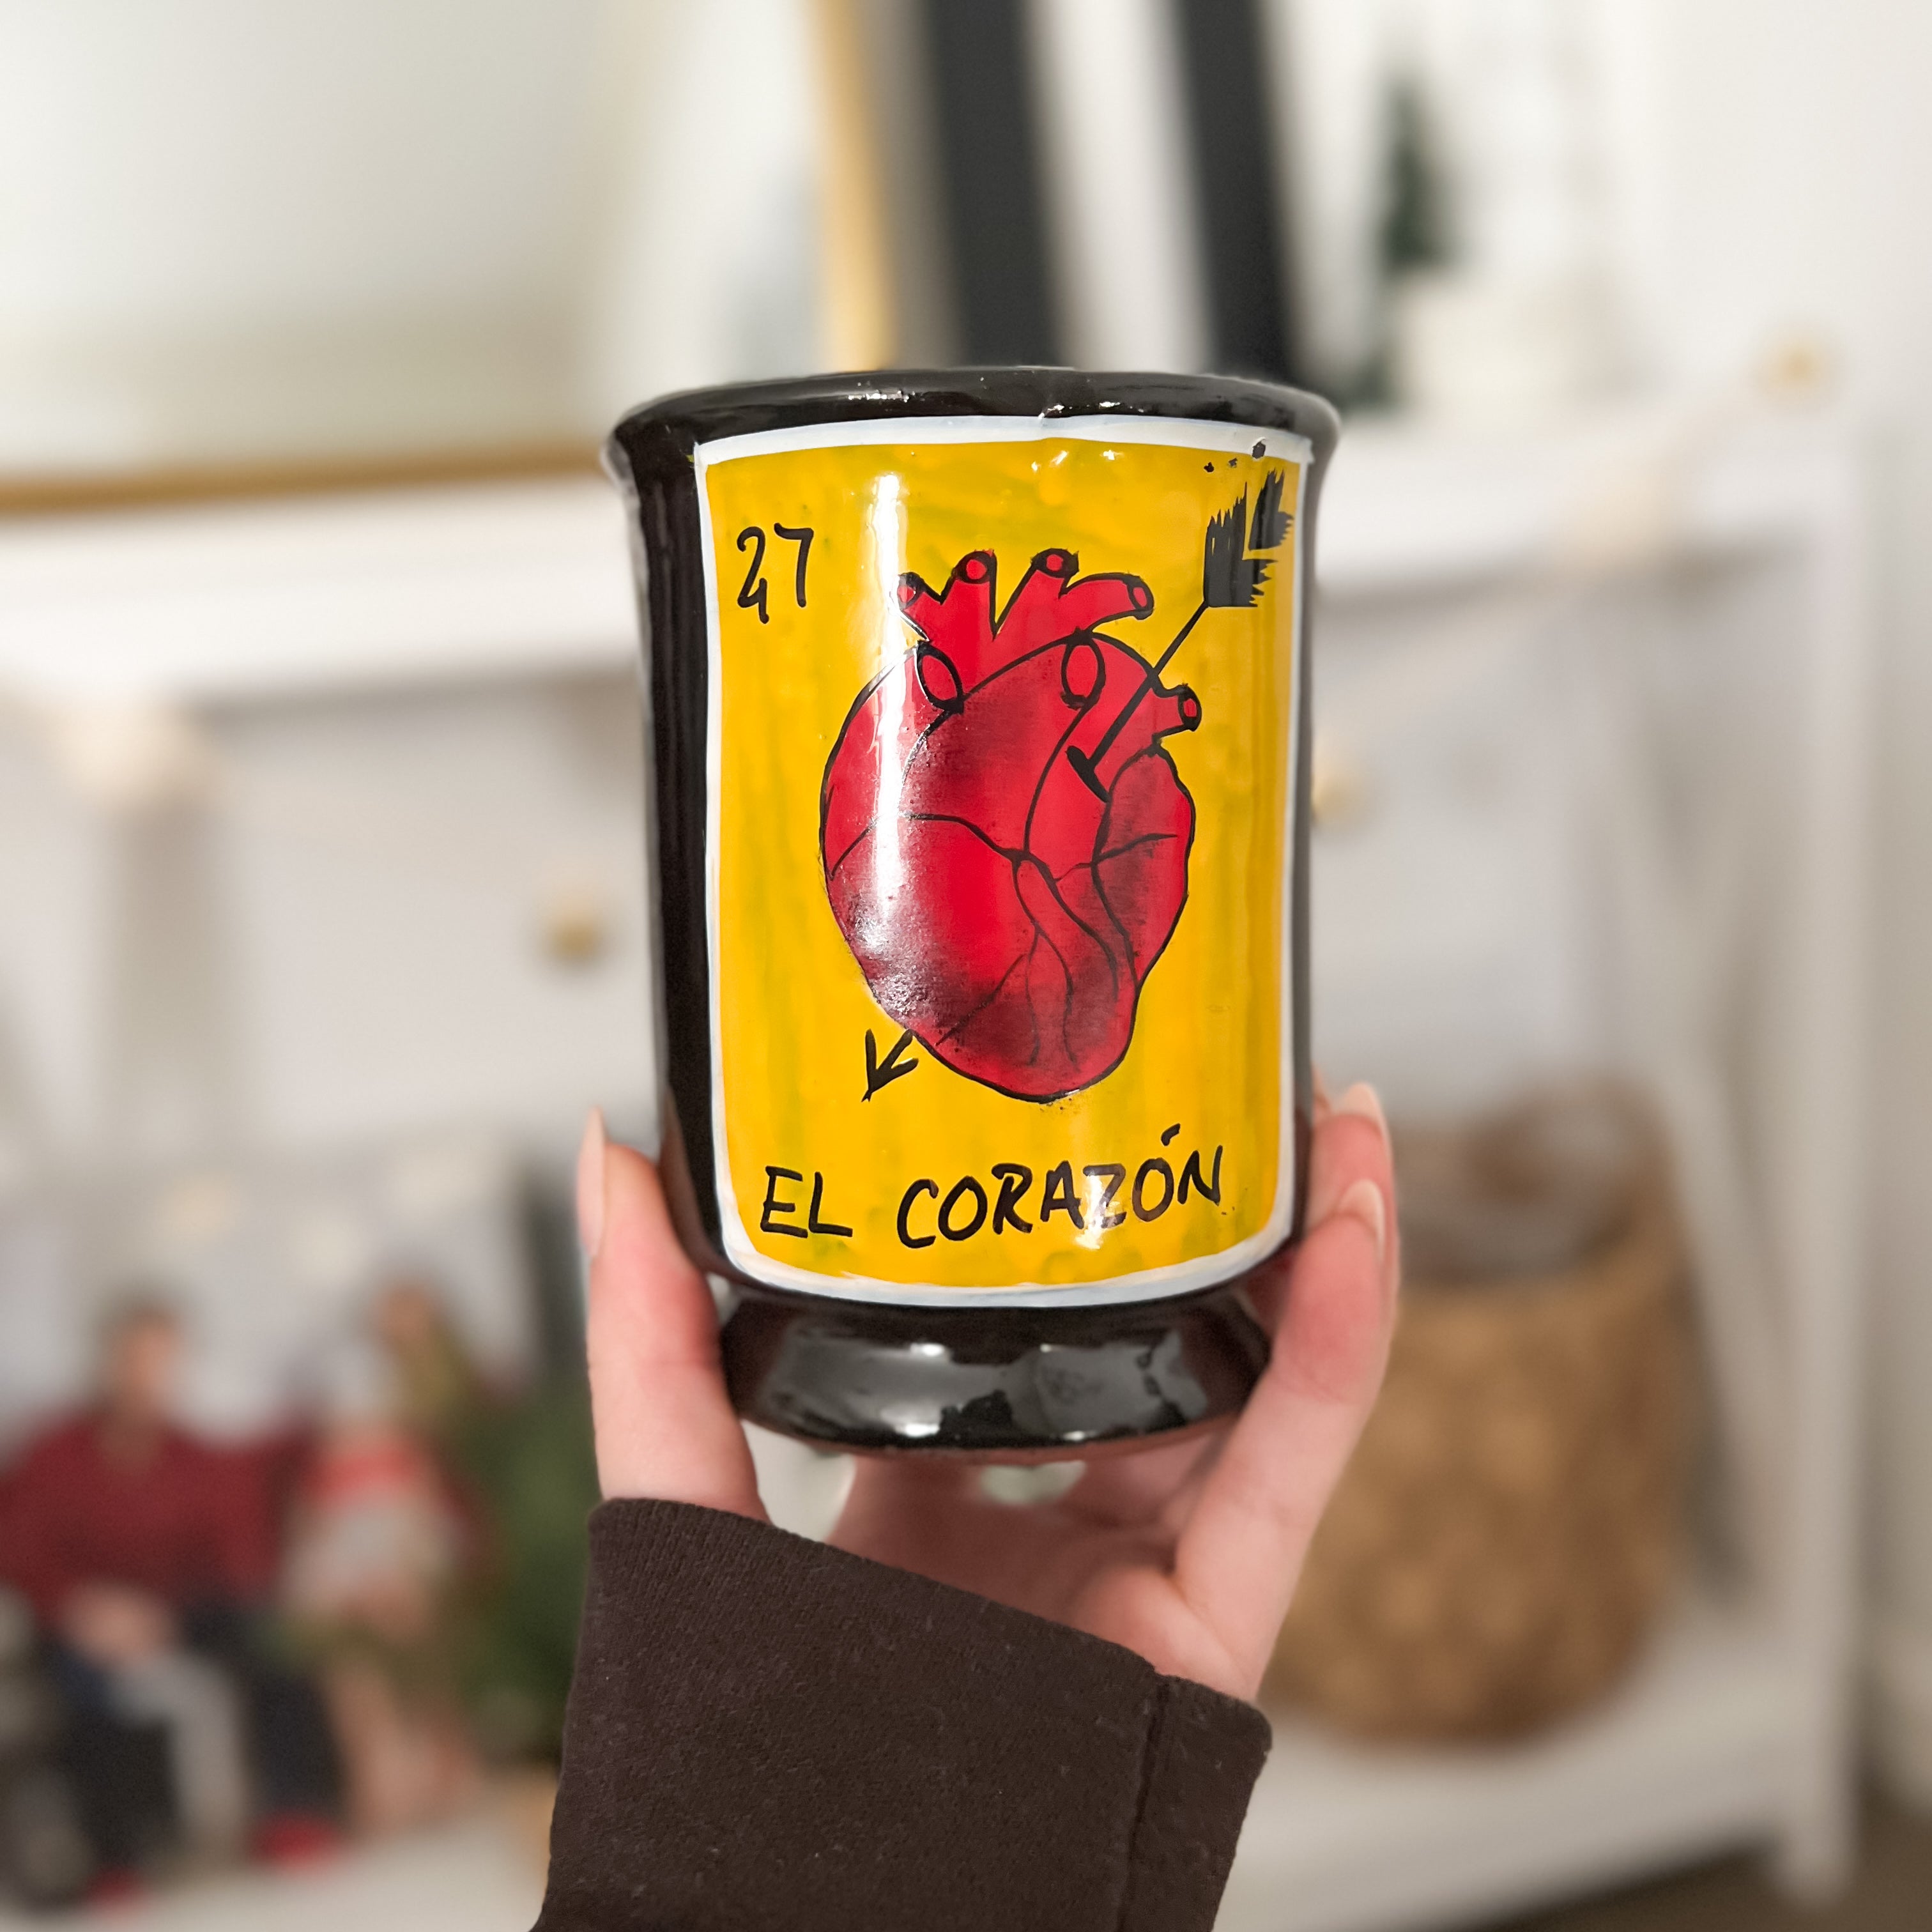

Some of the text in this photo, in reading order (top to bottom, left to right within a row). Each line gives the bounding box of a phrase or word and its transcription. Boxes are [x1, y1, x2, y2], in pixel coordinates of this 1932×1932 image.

[737, 522, 815, 625] 27
[760, 1123, 1223, 1249] EL CORAZÓN
